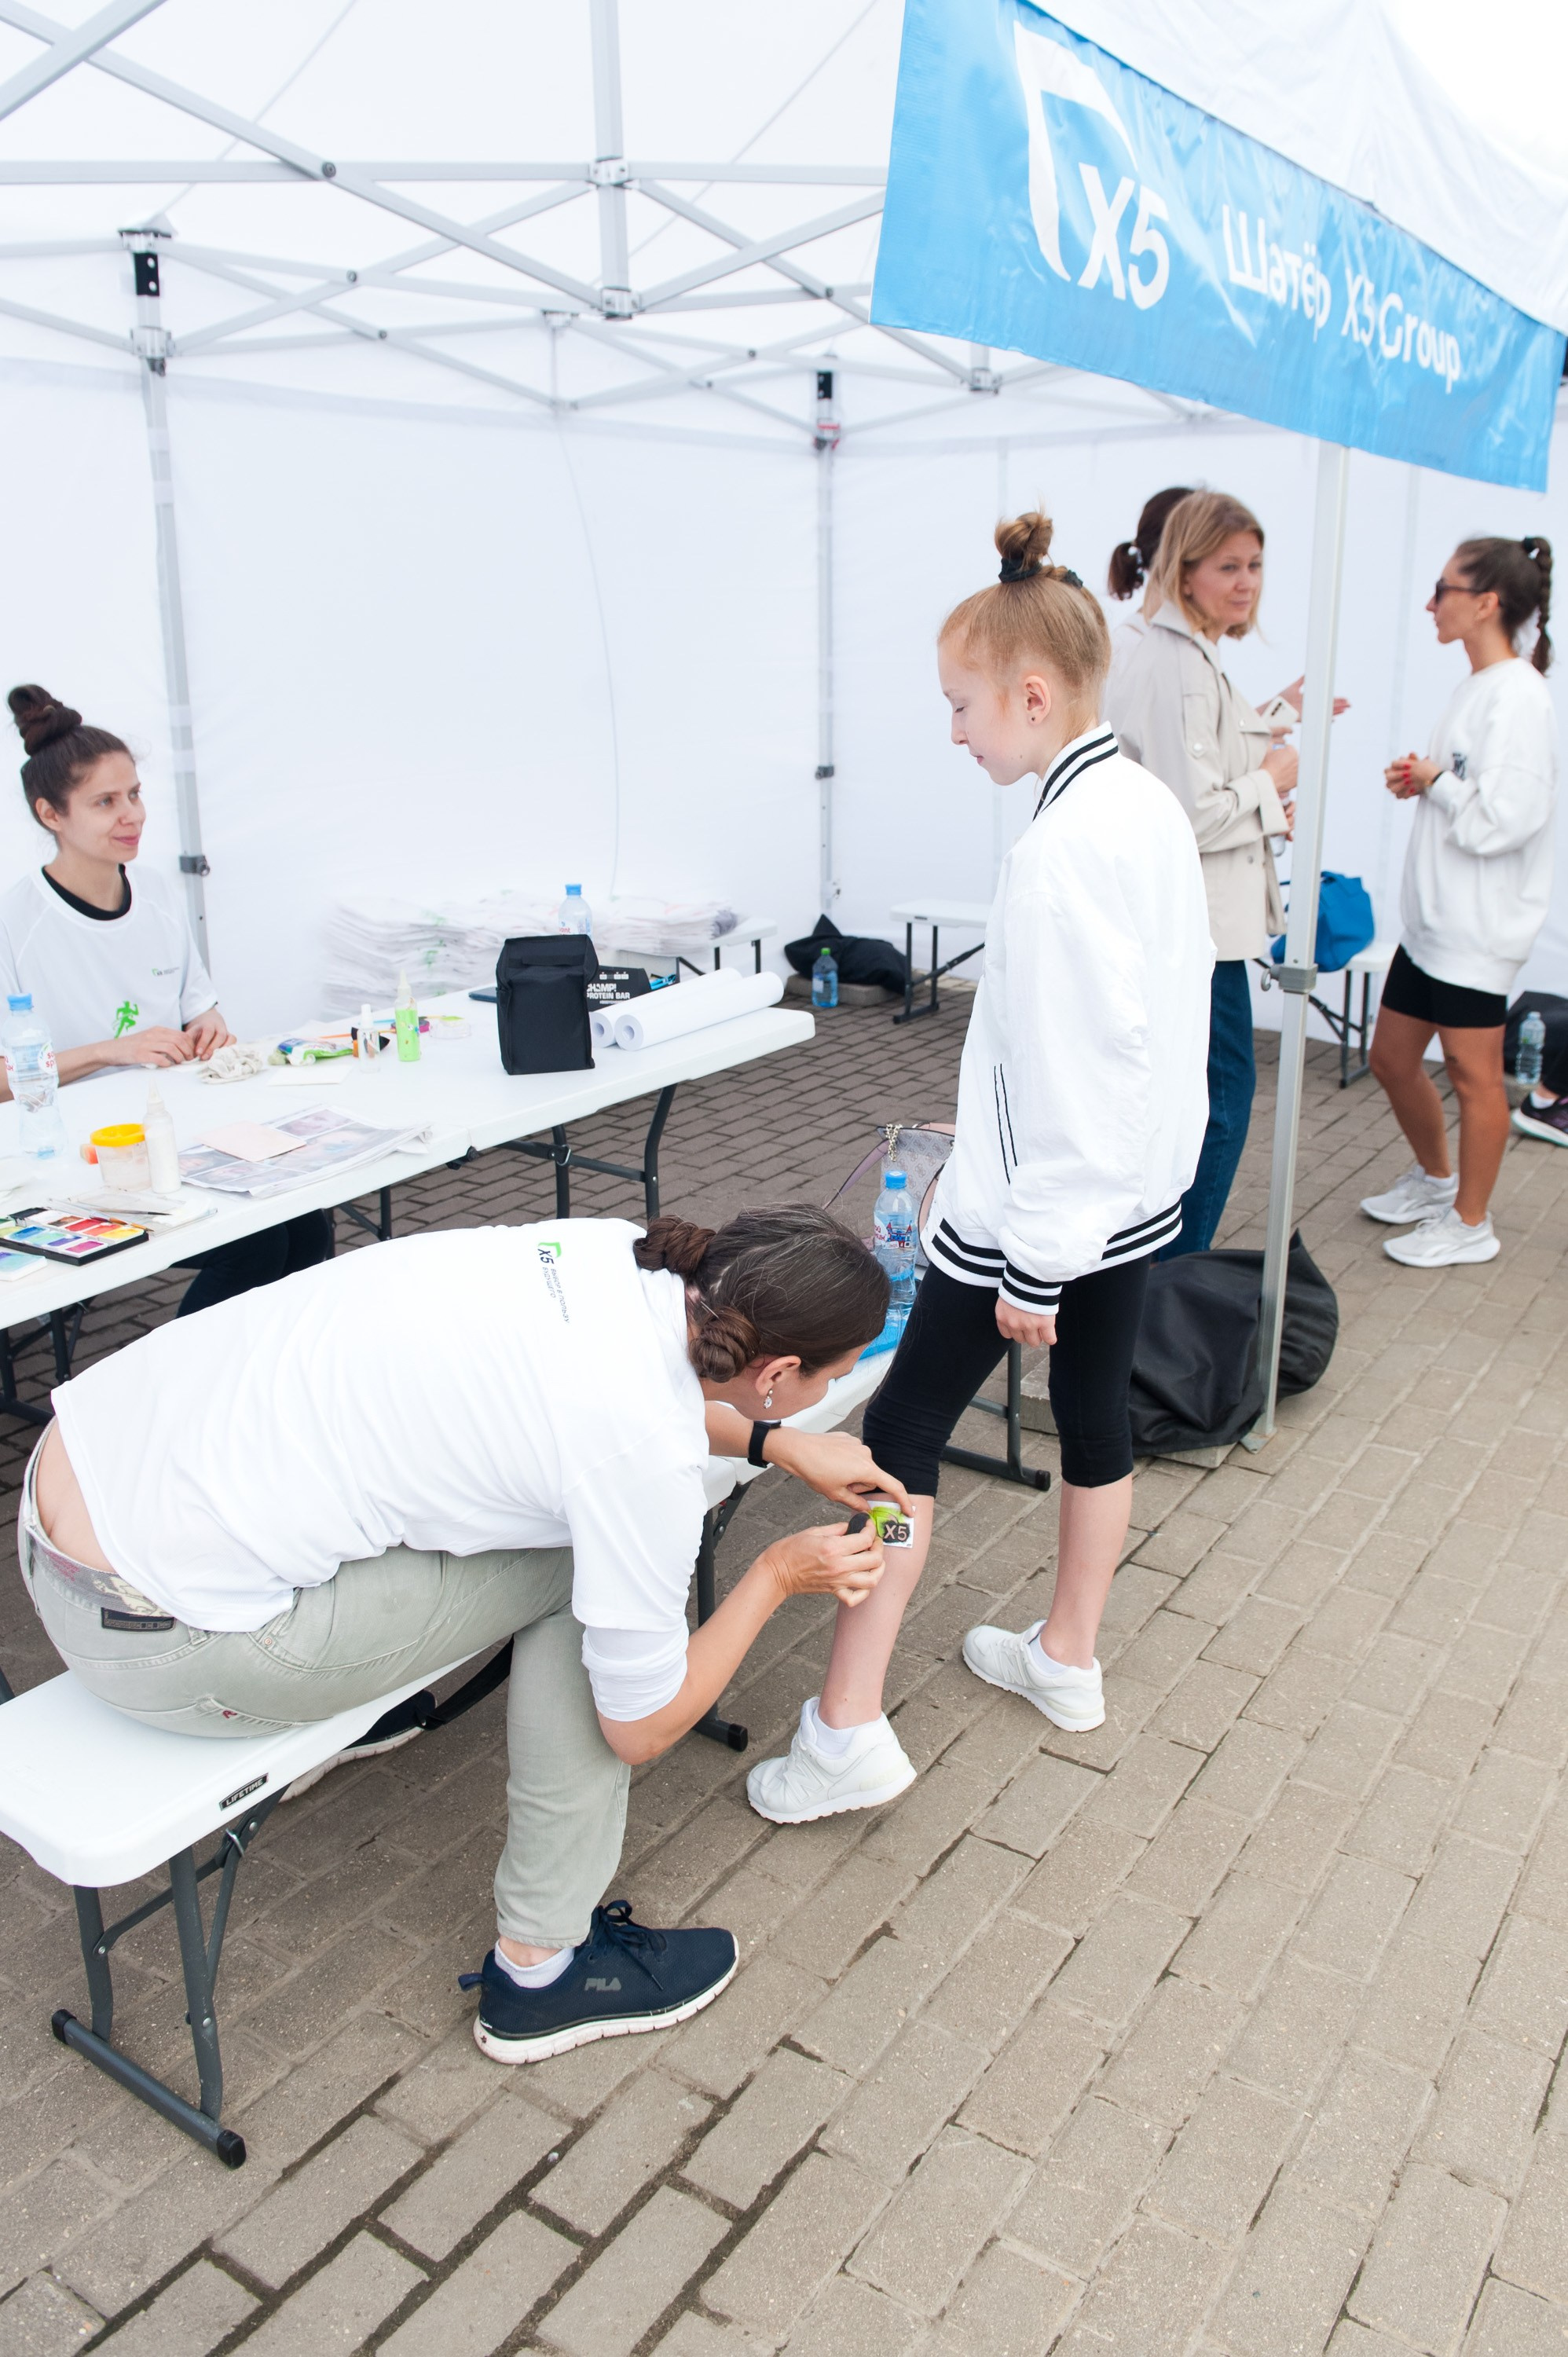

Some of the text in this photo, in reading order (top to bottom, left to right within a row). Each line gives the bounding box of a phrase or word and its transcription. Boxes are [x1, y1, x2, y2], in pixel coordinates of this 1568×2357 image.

[1077, 162, 1170, 311] X5
[1222, 204, 1332, 343] Шатёр
[1378, 292, 1460, 394] Group
[537, 1248, 555, 1264] X5
[884, 1523, 907, 1541] X5
[225, 1778, 263, 1806] LIFETIME
[584, 1977, 621, 1991] FILA
